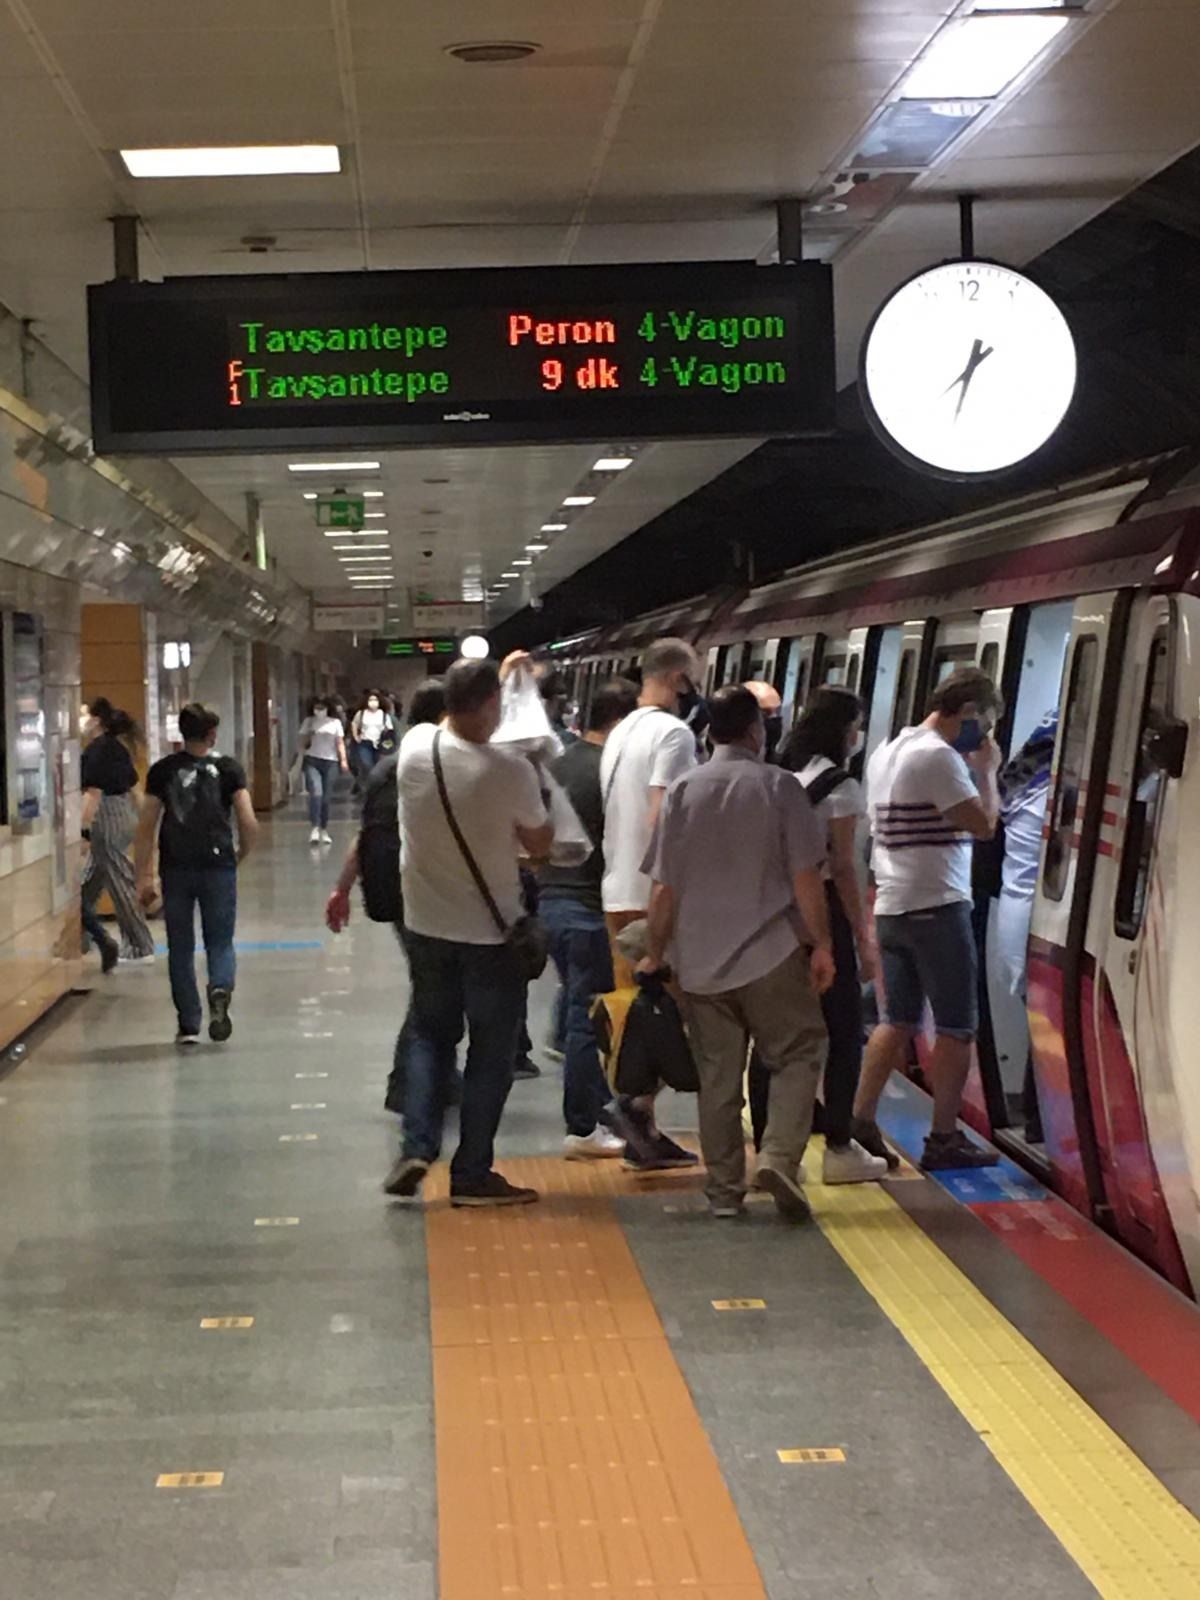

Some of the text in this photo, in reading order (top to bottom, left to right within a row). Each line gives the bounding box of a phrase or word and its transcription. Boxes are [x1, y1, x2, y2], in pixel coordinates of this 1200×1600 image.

[959, 280, 980, 301] 12
[508, 314, 616, 346] Peron
[637, 311, 785, 348] 4-Vagon
[541, 359, 562, 391] 9
[576, 357, 619, 390] dk
[639, 356, 786, 393] 4-Vagon
